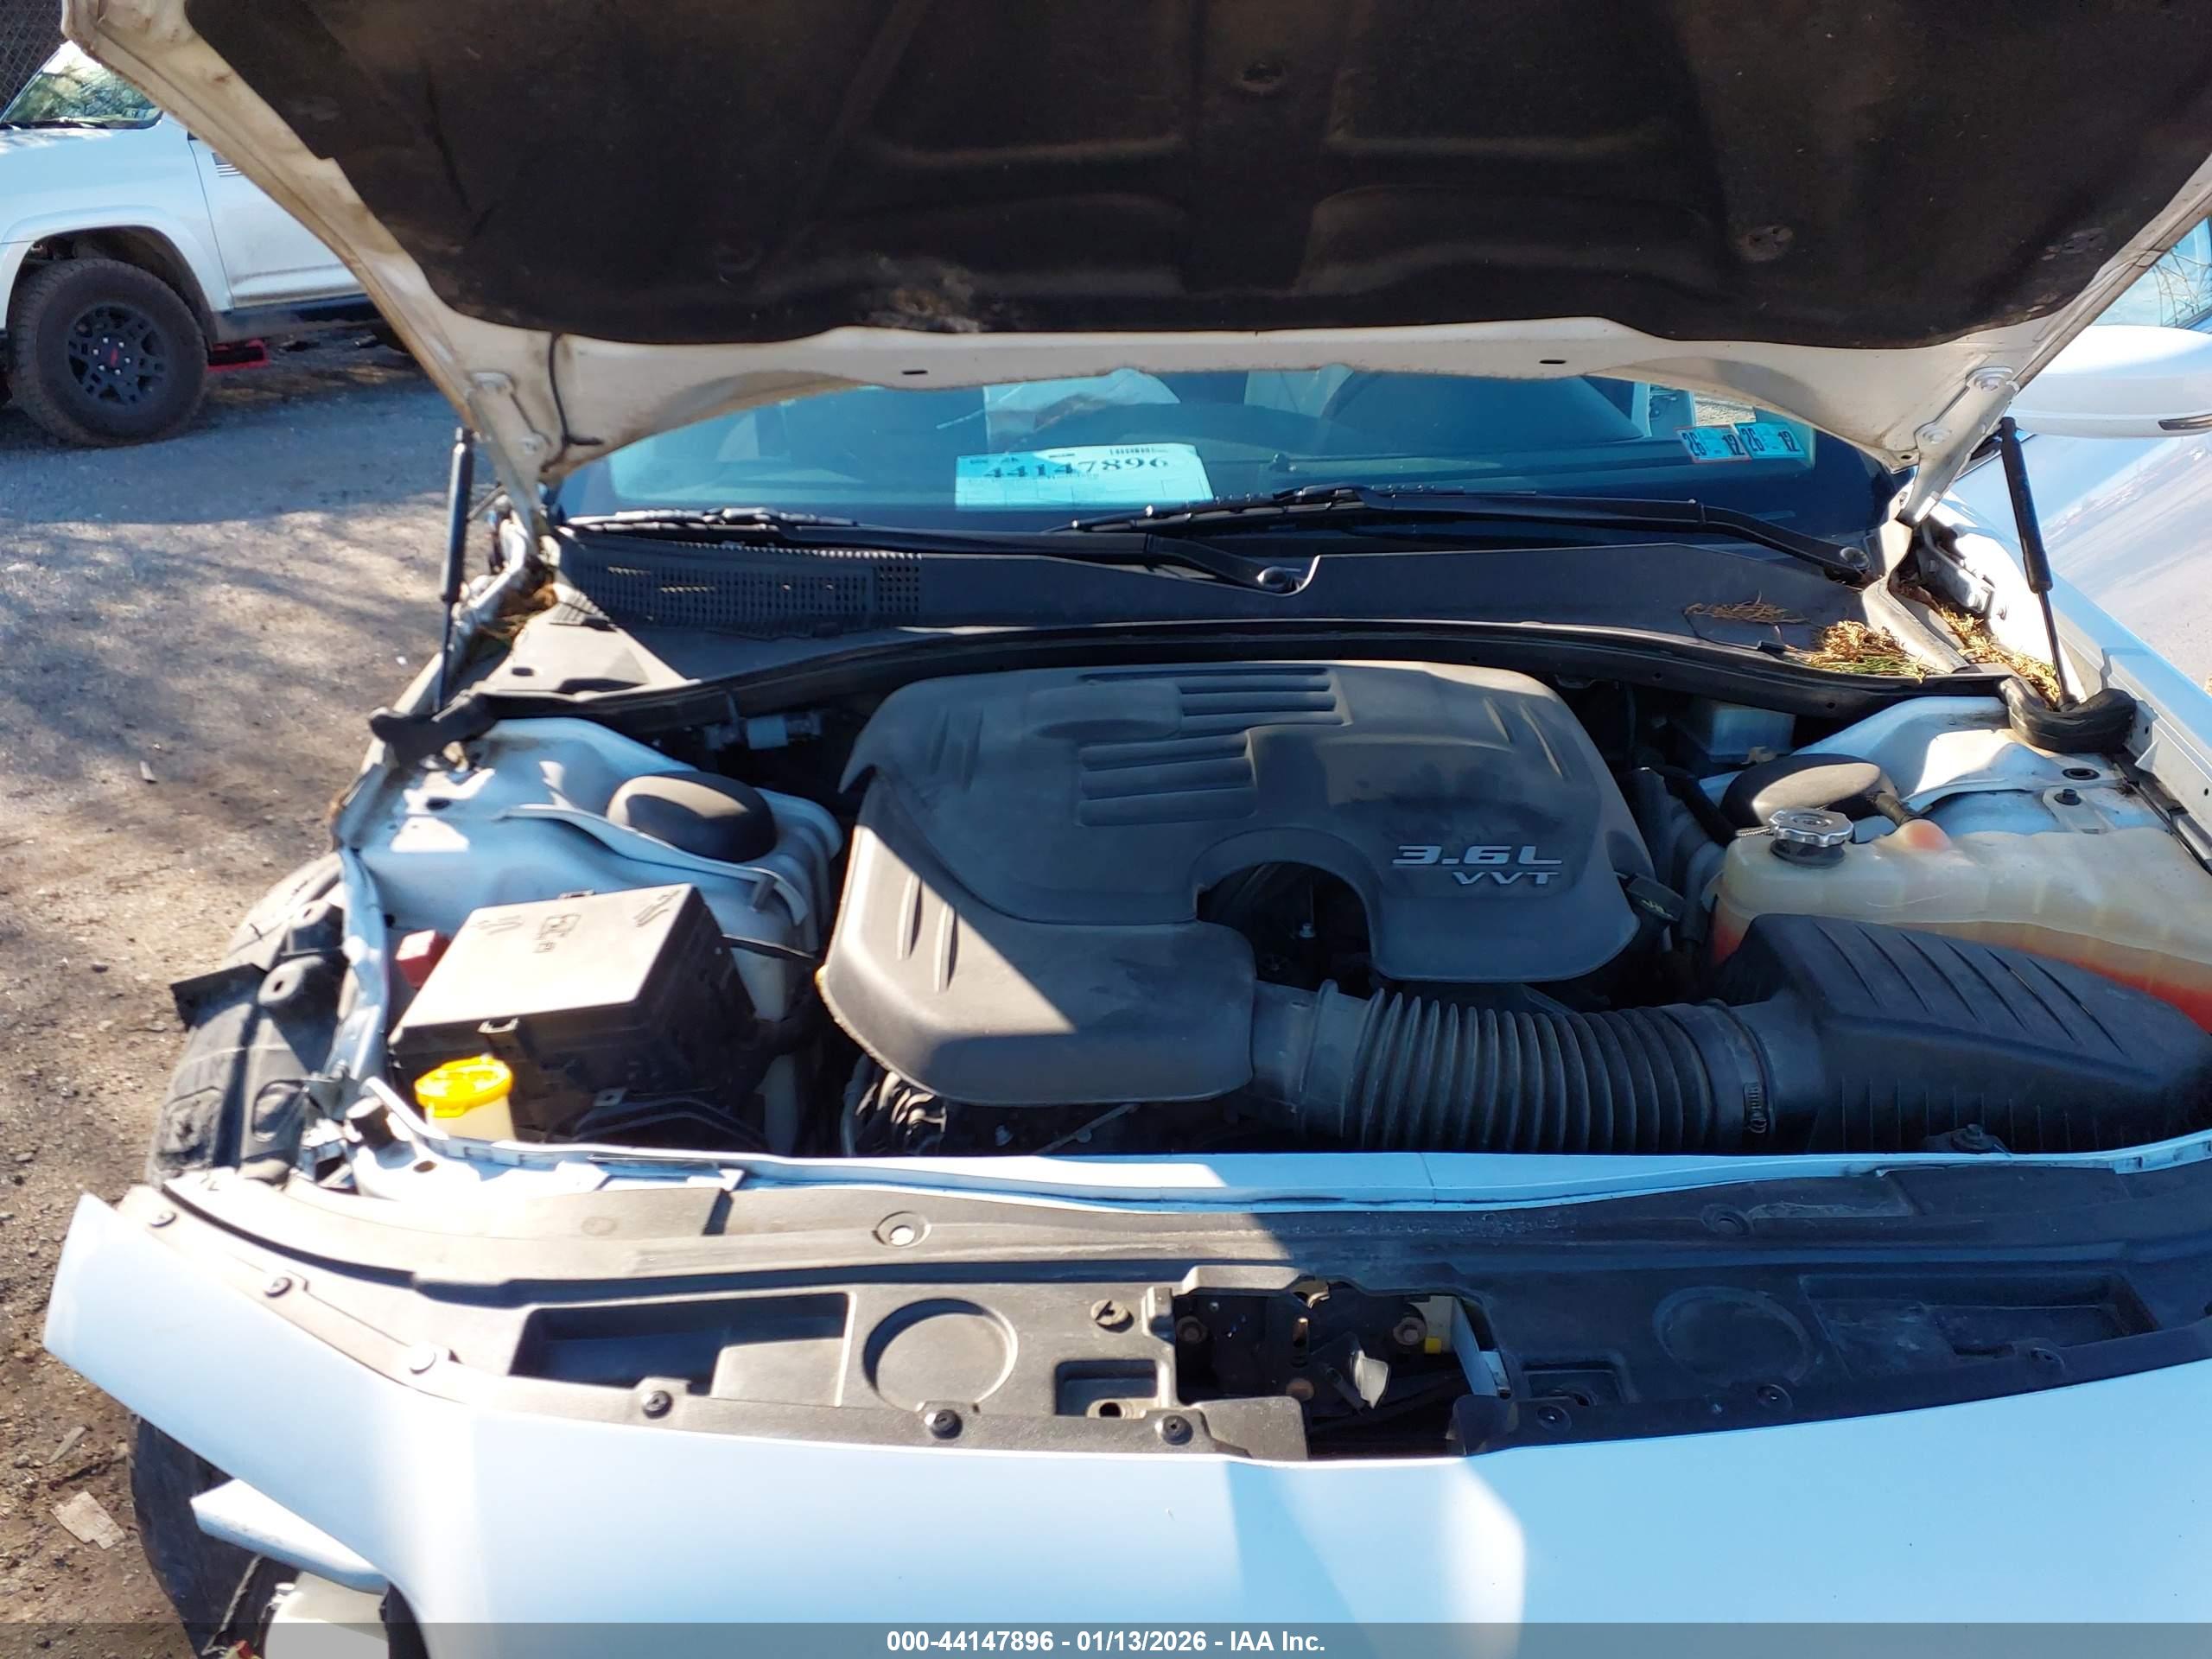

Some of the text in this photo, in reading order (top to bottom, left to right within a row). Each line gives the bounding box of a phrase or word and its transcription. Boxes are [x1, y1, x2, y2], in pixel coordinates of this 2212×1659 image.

[1681, 432, 1745, 456] 26 12
[1740, 428, 1800, 452] 26 12
[983, 457, 1169, 478] 44147896
[1392, 845, 1562, 864] 3.6L
[1452, 871, 1560, 885] VVT
